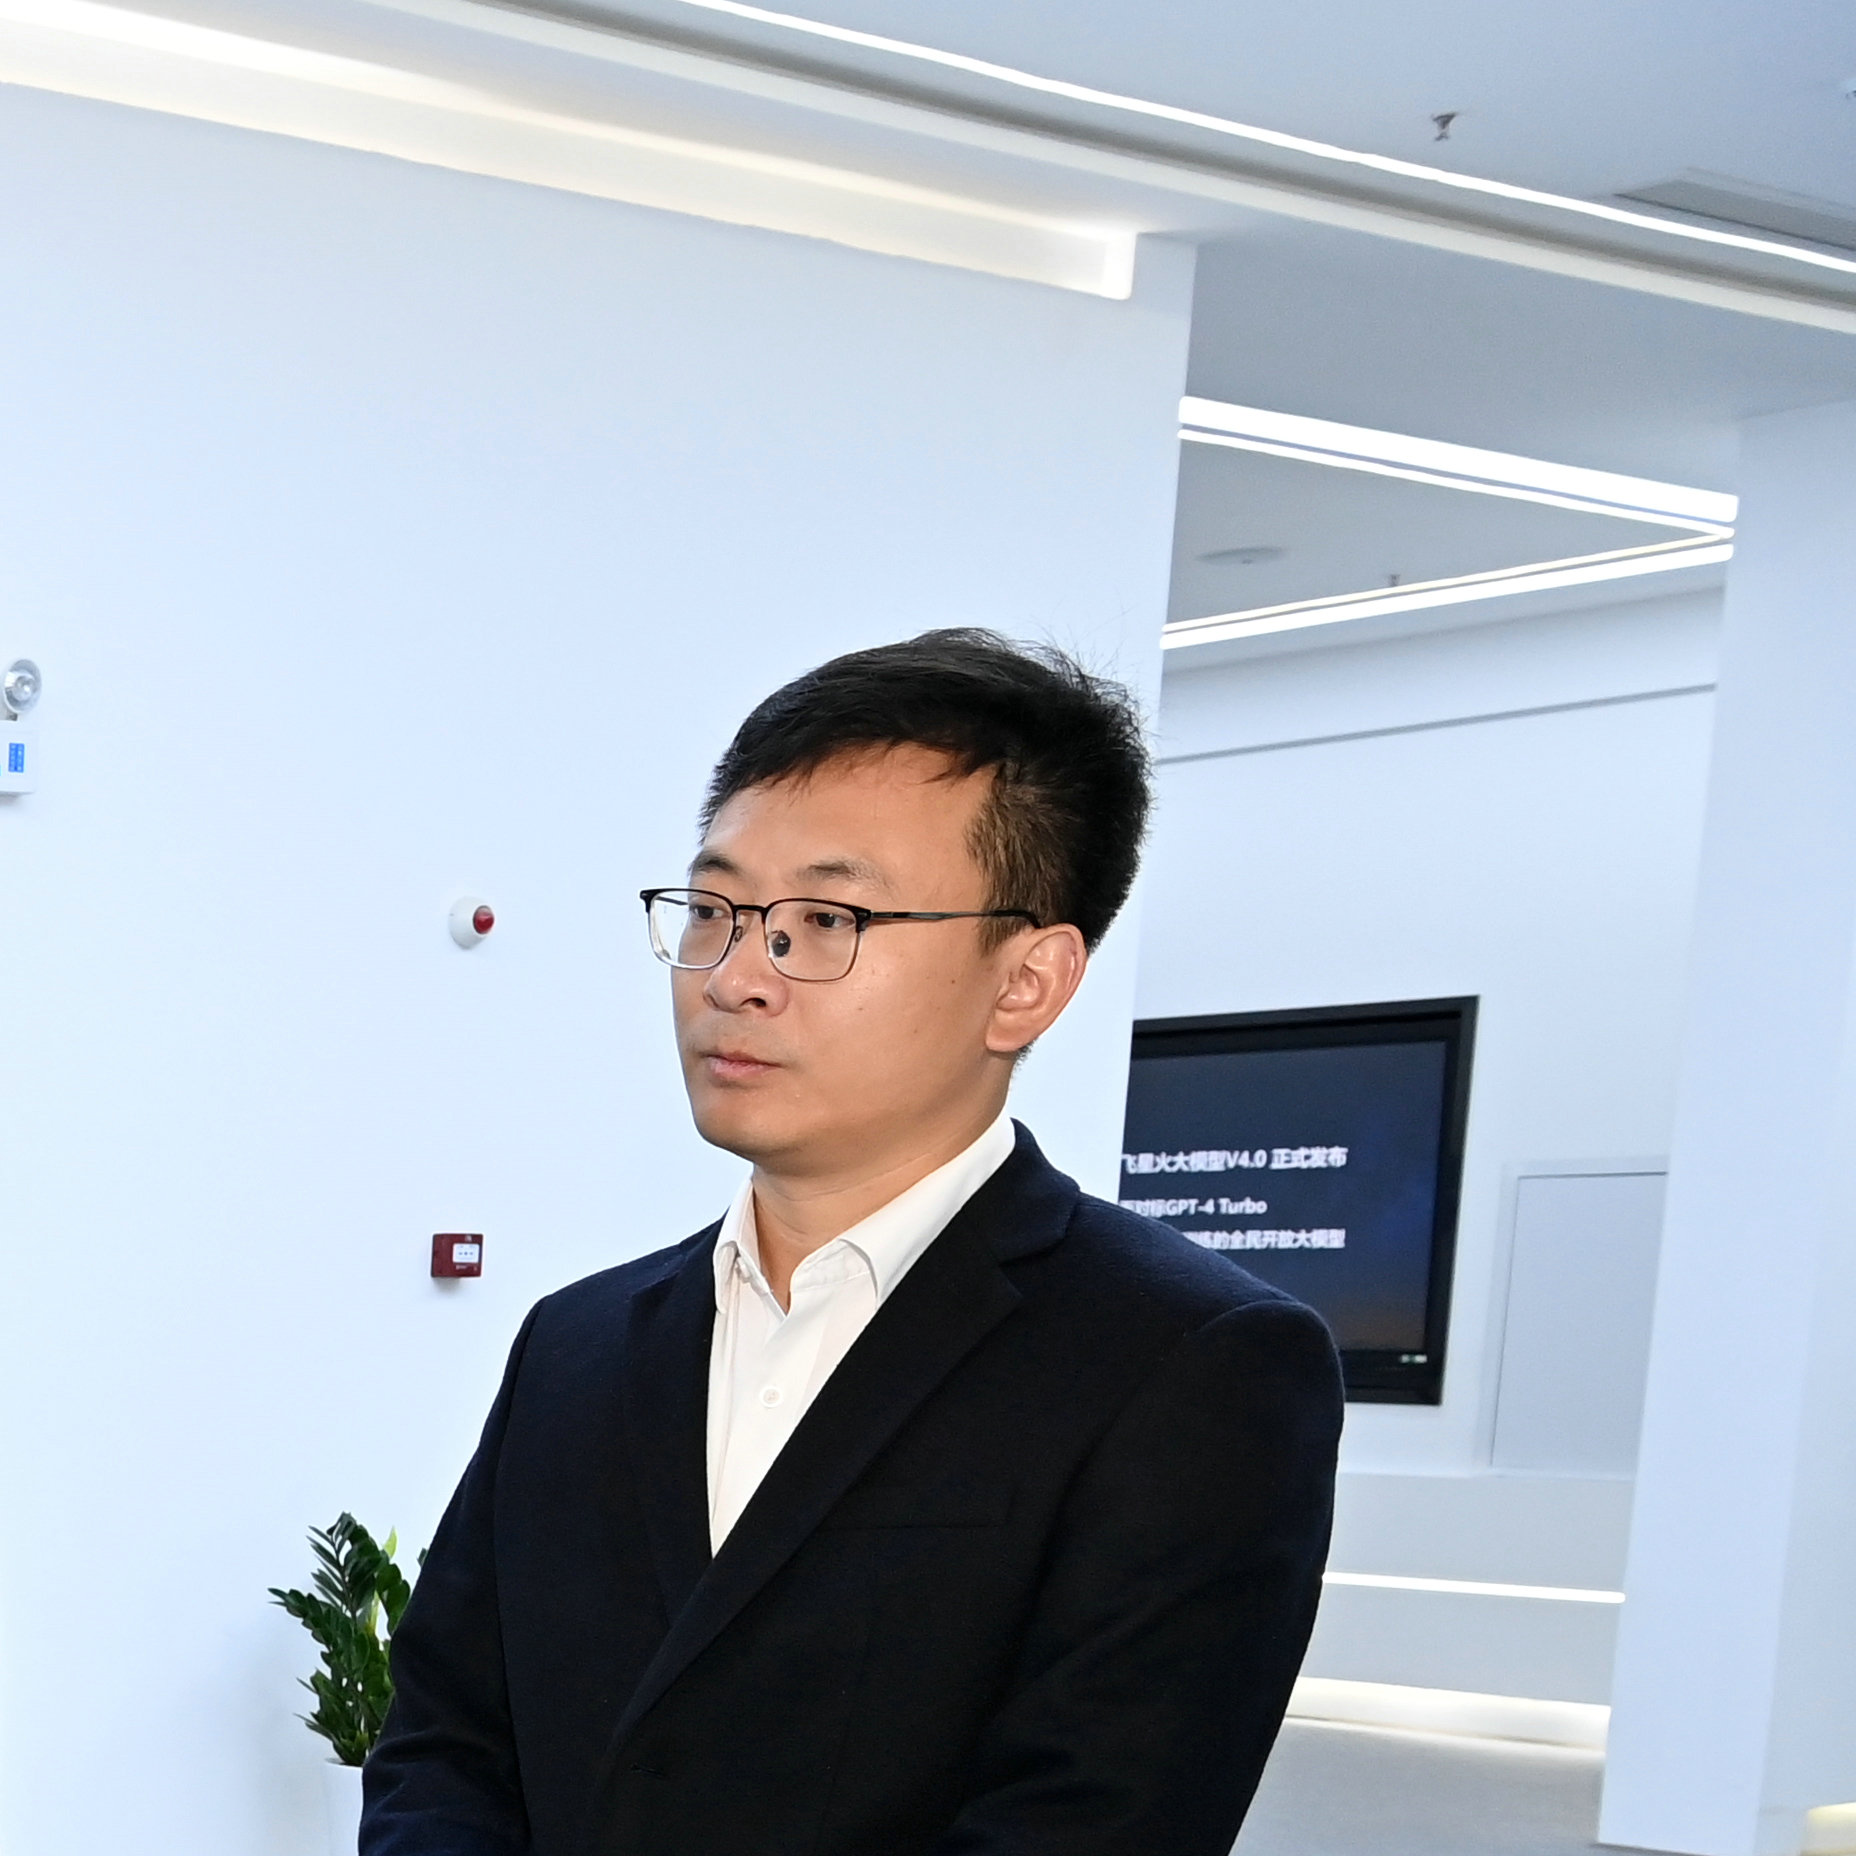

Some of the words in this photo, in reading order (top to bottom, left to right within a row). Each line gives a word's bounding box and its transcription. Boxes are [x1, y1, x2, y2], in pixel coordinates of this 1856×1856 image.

[1270, 1146, 1349, 1170] 正式发布
[1218, 1197, 1268, 1215] Turbo
